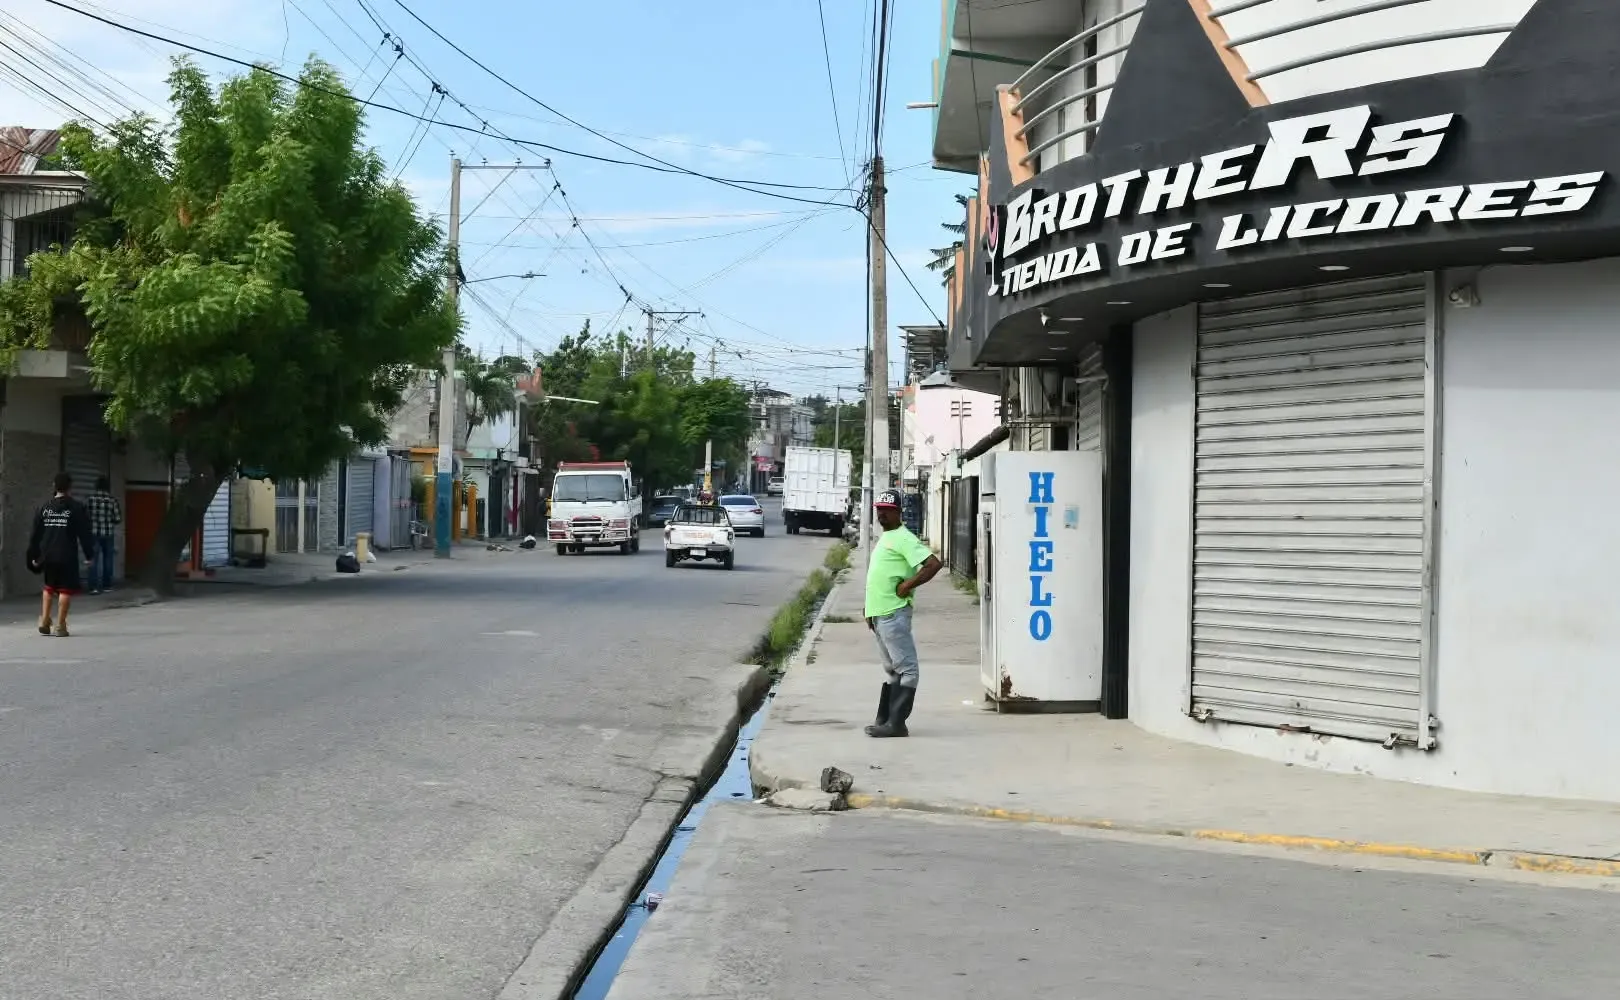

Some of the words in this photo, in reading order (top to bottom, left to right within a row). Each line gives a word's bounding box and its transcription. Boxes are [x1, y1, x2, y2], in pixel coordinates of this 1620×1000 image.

[1000, 243, 1102, 296] TIENDA
[1117, 221, 1194, 267] DE
[1215, 171, 1606, 251] LICORES
[1003, 105, 1455, 259] BROTHERS
[1028, 472, 1054, 641] HIELO
